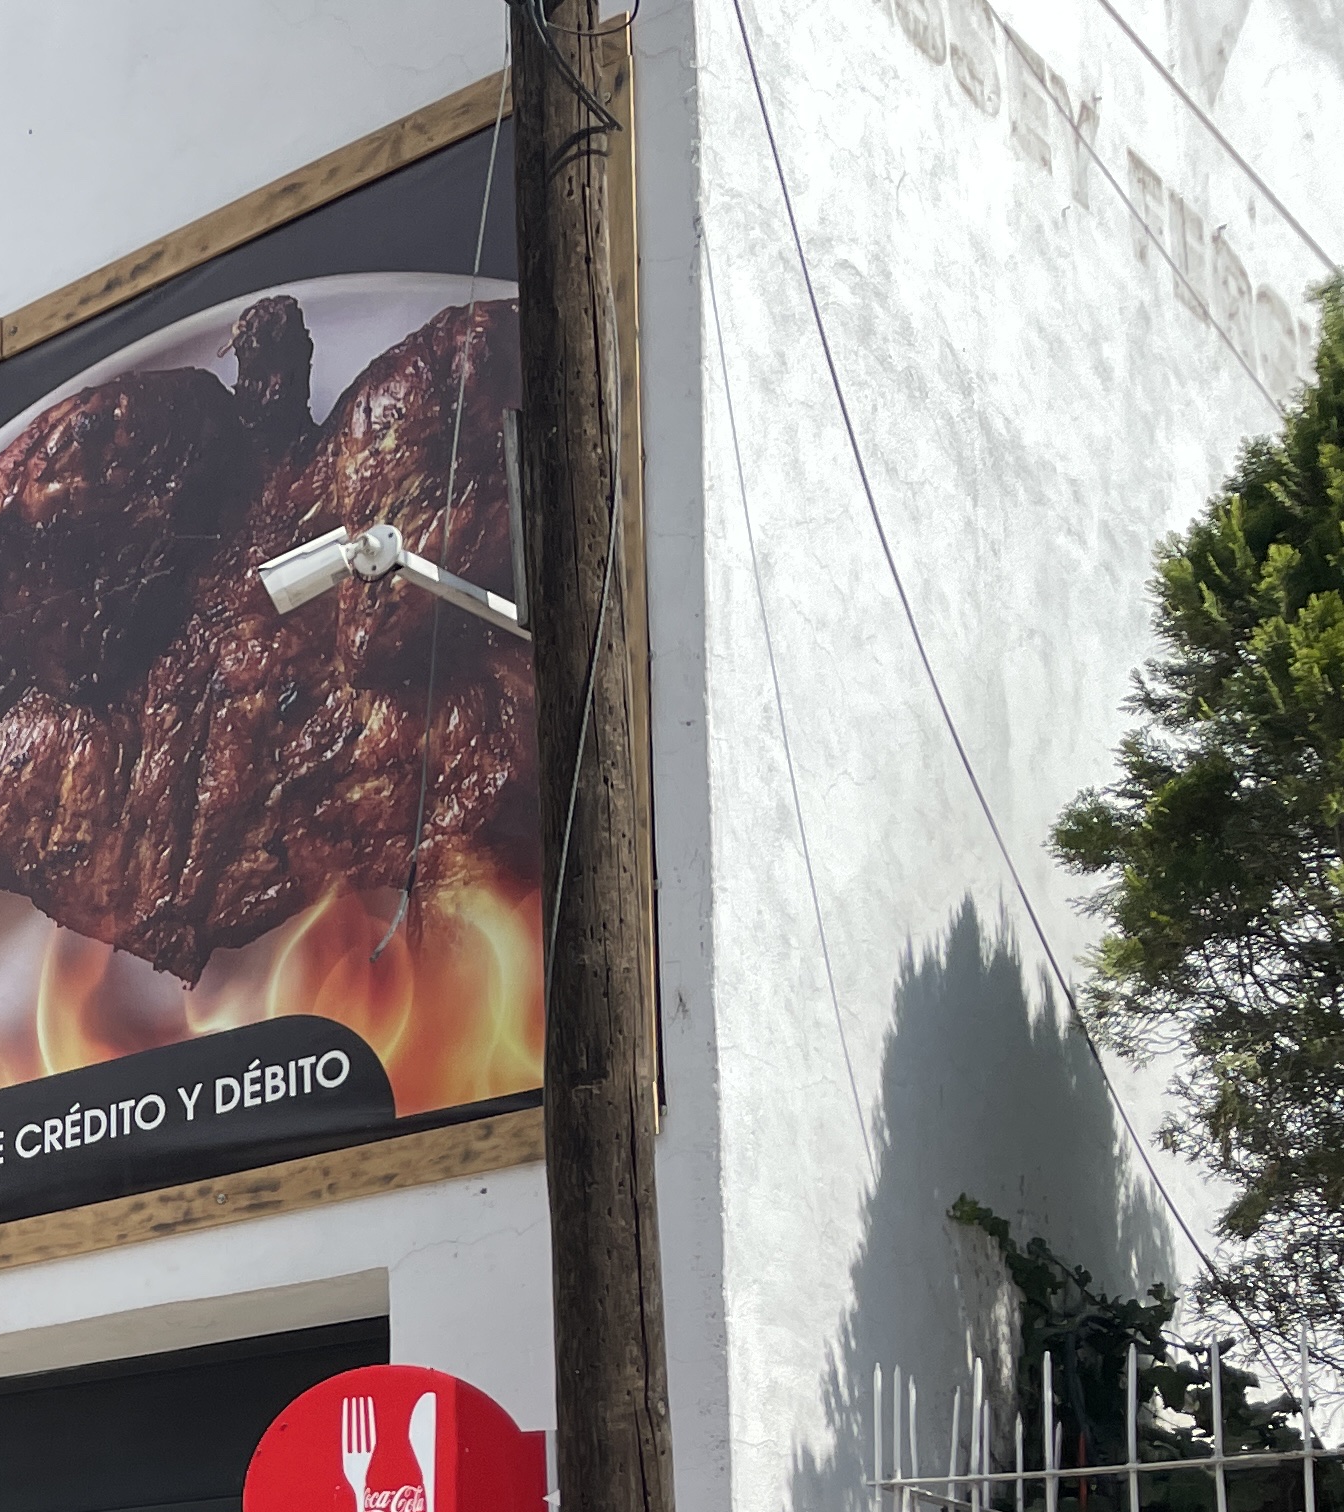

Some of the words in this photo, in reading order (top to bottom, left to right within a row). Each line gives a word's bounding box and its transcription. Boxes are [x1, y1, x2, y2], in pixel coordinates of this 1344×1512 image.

[13, 1092, 165, 1159] CRÉDITO
[177, 1084, 203, 1123] Y
[214, 1049, 351, 1116] DÉBITO
